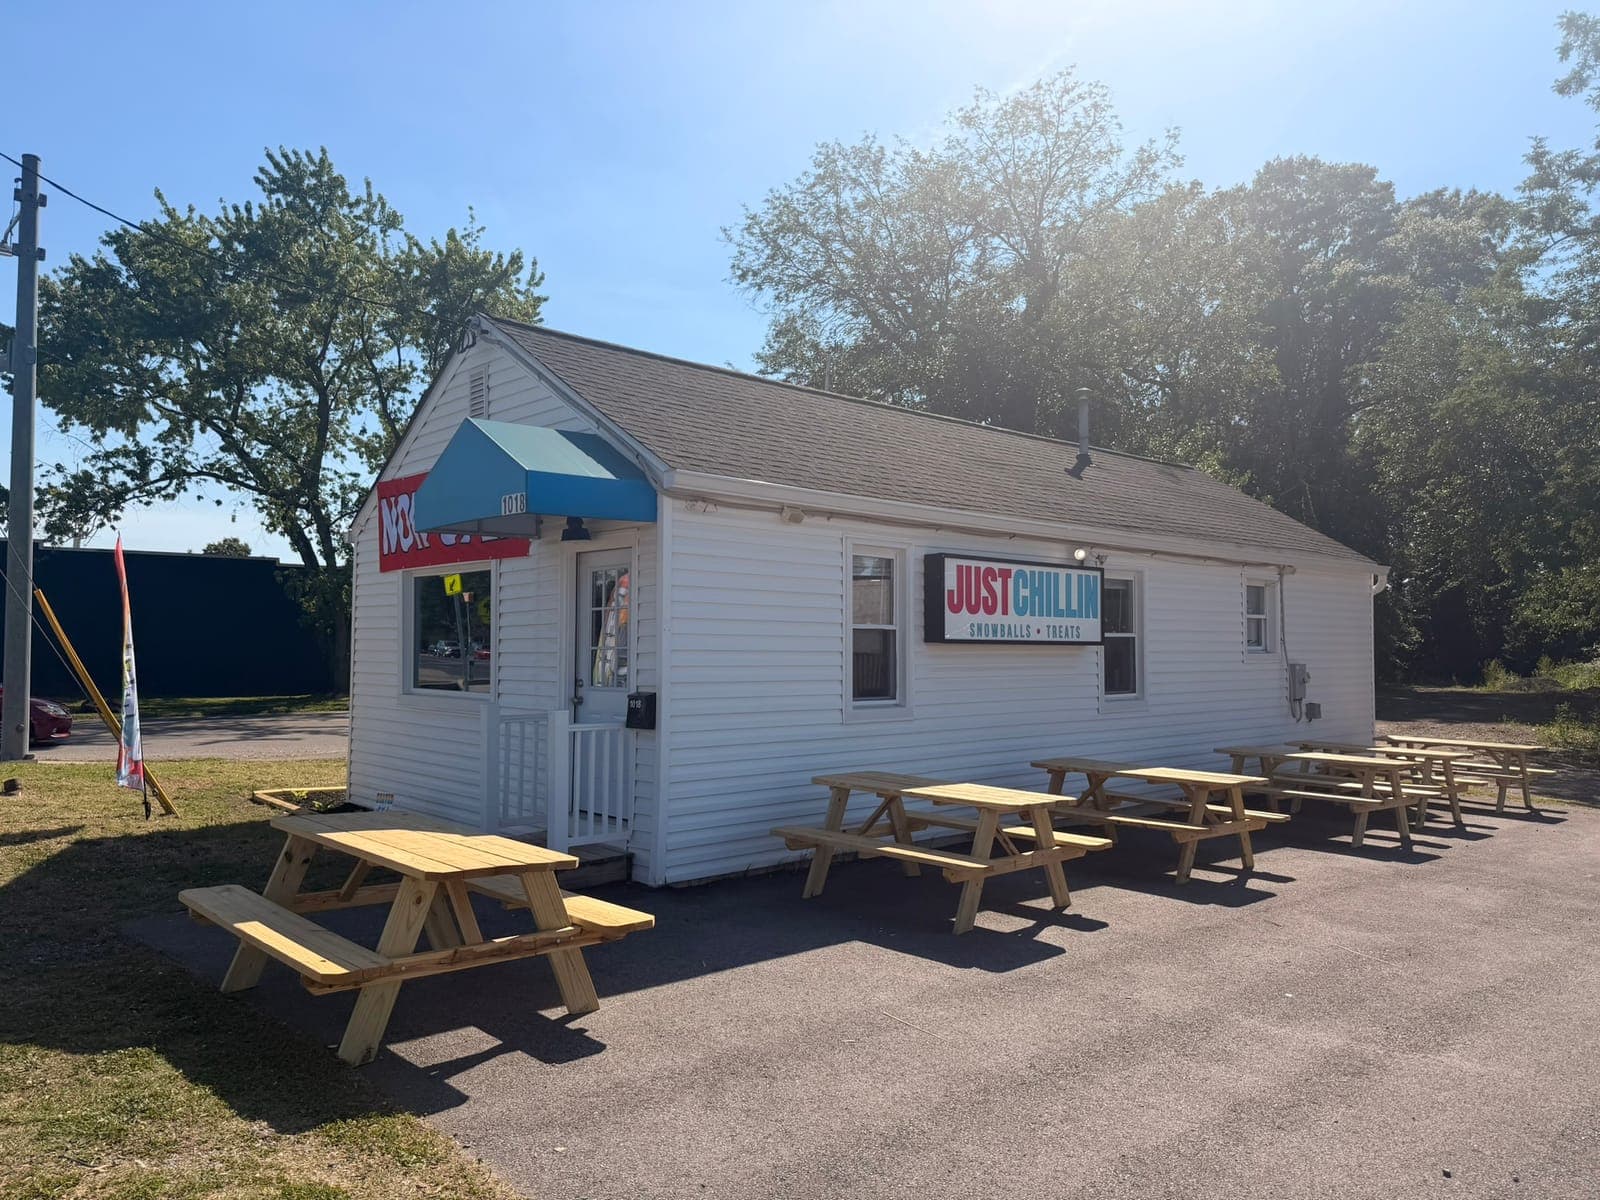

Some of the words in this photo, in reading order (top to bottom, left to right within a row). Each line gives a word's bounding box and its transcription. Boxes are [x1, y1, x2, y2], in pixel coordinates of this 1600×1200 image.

[503, 494, 525, 514] 1018
[947, 564, 1011, 616] JUST
[1013, 569, 1098, 619] CHILLIN
[969, 622, 1031, 638] SNOWBALLS
[1046, 624, 1081, 639] TREATS
